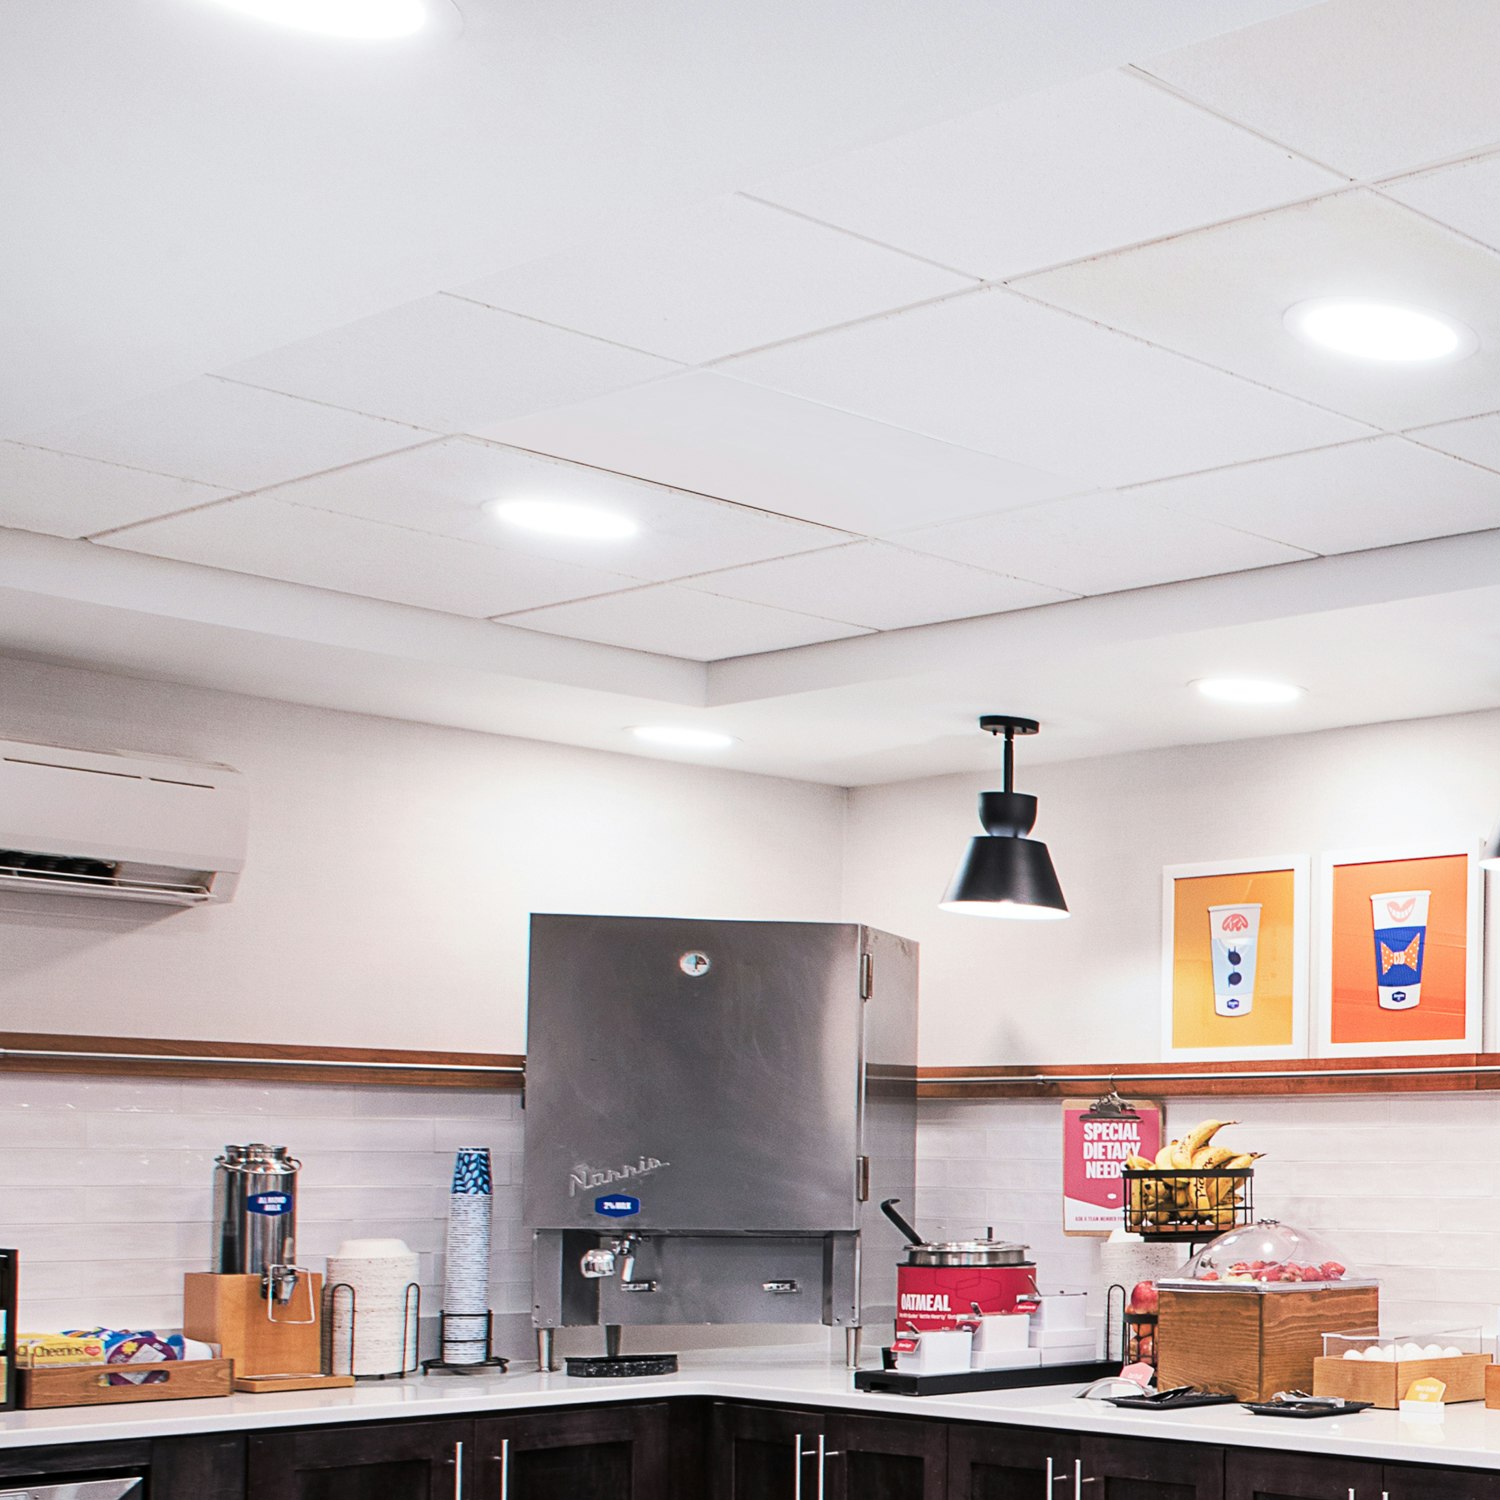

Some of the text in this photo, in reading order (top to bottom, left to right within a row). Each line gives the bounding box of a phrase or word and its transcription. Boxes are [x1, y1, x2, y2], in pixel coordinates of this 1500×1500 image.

[1083, 1122, 1141, 1141] SPECIAL
[1083, 1141, 1142, 1160] DIETARY
[901, 1293, 952, 1312] OATMEAL
[34, 1345, 84, 1357] Cheerios
